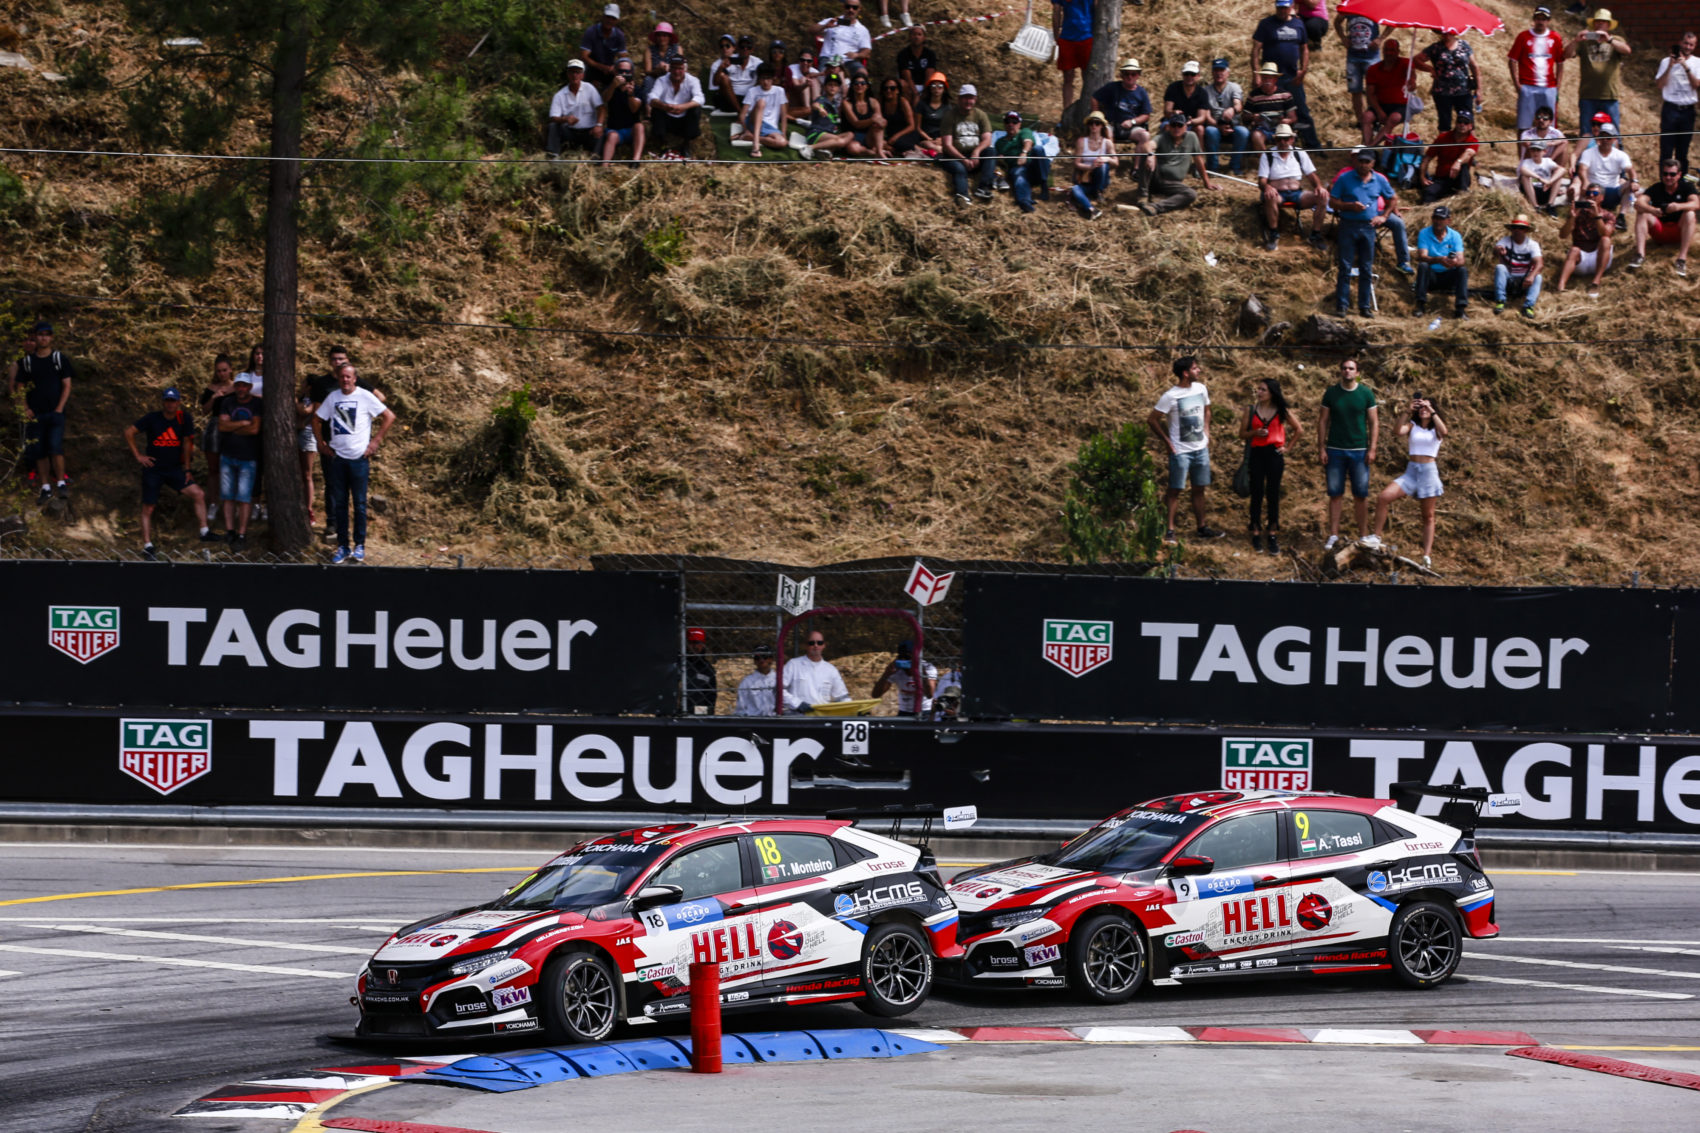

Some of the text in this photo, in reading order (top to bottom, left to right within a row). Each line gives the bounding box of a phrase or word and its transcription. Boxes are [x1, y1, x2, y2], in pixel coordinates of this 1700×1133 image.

[56, 611, 114, 628] TAG
[1050, 624, 1107, 642] TAG
[52, 632, 119, 657] HEUER
[1045, 646, 1112, 672] HEUER
[127, 724, 203, 747] TAG
[844, 723, 867, 742] 28
[1231, 743, 1305, 765] TAG
[124, 752, 207, 787] HEUER
[1127, 810, 1187, 824] YOKOHAMA
[1295, 812, 1309, 839] 9
[582, 843, 650, 853] YOKOHAMA
[1319, 833, 1363, 850] A. Tassi
[1404, 841, 1444, 851] brose
[755, 836, 782, 865] 18
[779, 859, 833, 877] T. Monteiro
[867, 859, 907, 872] brose
[1386, 863, 1459, 885] KCMG
[1180, 883, 1190, 897] 9
[1208, 878, 1241, 890] OSCARO
[853, 880, 923, 907] KCMG
[646, 914, 664, 928] 18
[676, 907, 710, 920] OSCARO
[1222, 894, 1292, 936] HELL
[691, 922, 760, 963] HELL
[1175, 931, 1204, 945] Castrol
[1223, 930, 1292, 945] ENERGY DRINK
[990, 955, 1019, 964] brose
[1031, 946, 1057, 963] KW
[1313, 950, 1388, 962] Honda Racing
[646, 964, 676, 980] Castrol
[734, 961, 762, 971] DRINK
[786, 976, 861, 993] Honda Racing
[500, 987, 528, 1006] KW
[455, 1002, 487, 1013] brose
[505, 1020, 536, 1030] YOKOHAMA
